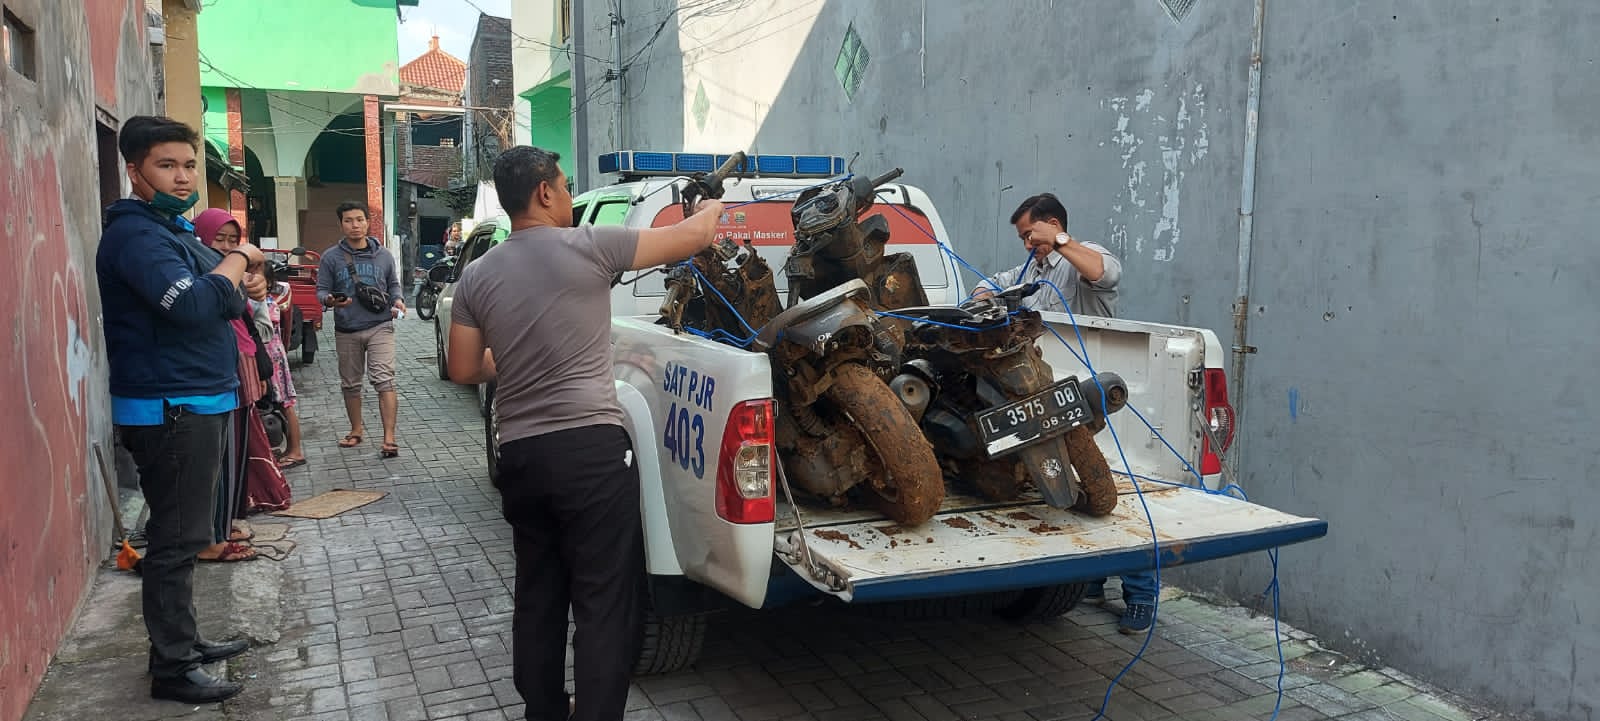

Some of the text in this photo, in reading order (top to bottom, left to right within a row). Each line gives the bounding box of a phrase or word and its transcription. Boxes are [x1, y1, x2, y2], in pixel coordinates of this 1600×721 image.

[726, 231, 751, 240] Pakai
[753, 230, 788, 240] Masker!
[160, 286, 180, 310] NOW
[664, 361, 715, 412] SAT PJR
[987, 418, 1000, 434] L
[1007, 399, 1044, 426] 3575
[664, 402, 705, 480] 403
